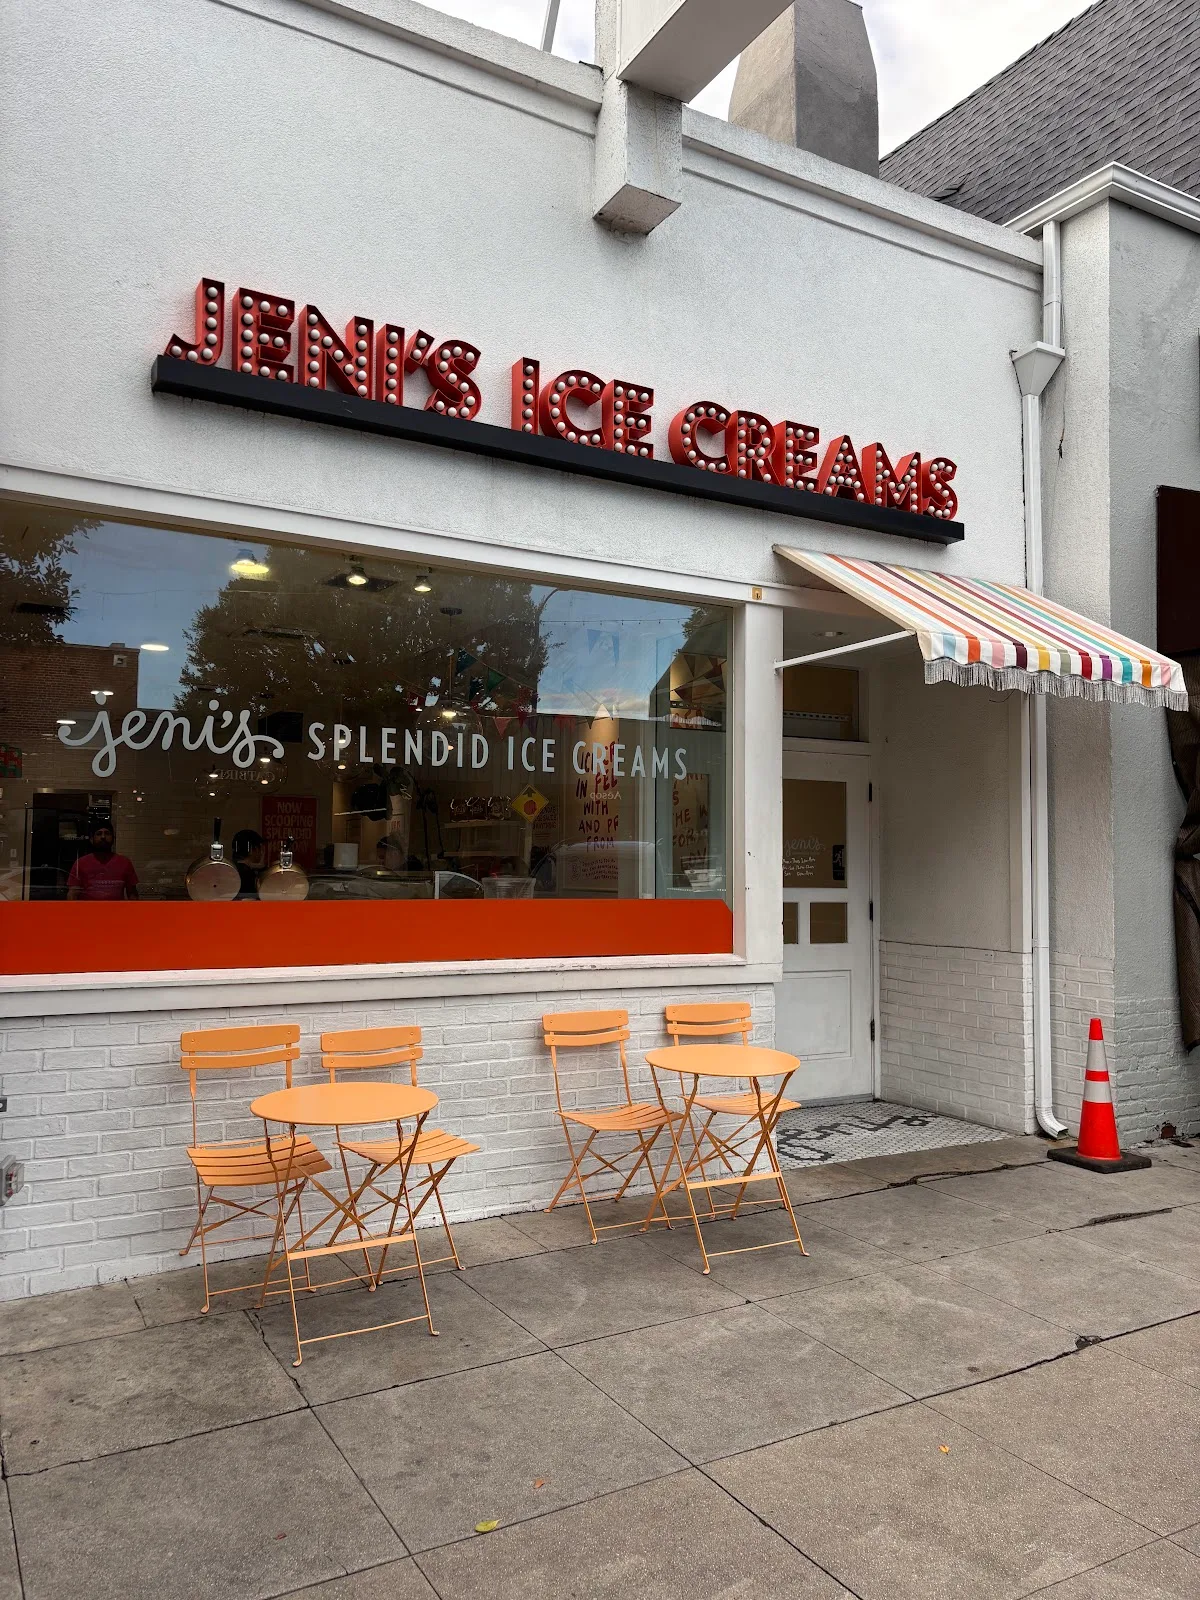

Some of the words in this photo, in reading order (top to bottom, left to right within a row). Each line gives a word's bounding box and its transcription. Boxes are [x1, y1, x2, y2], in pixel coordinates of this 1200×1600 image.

[164, 277, 482, 421] JENI'S
[512, 357, 654, 460] ICE
[668, 400, 959, 521] CREAMS
[57, 691, 285, 778] jeni's
[307, 721, 490, 769] SPLENDID
[508, 735, 556, 773] ICE
[571, 740, 689, 781] CREAMS
[276, 800, 303, 815] NOW
[583, 800, 609, 816] WITH
[265, 814, 315, 828] SCOOPING
[578, 819, 600, 835] AND
[586, 836, 614, 852] FROM
